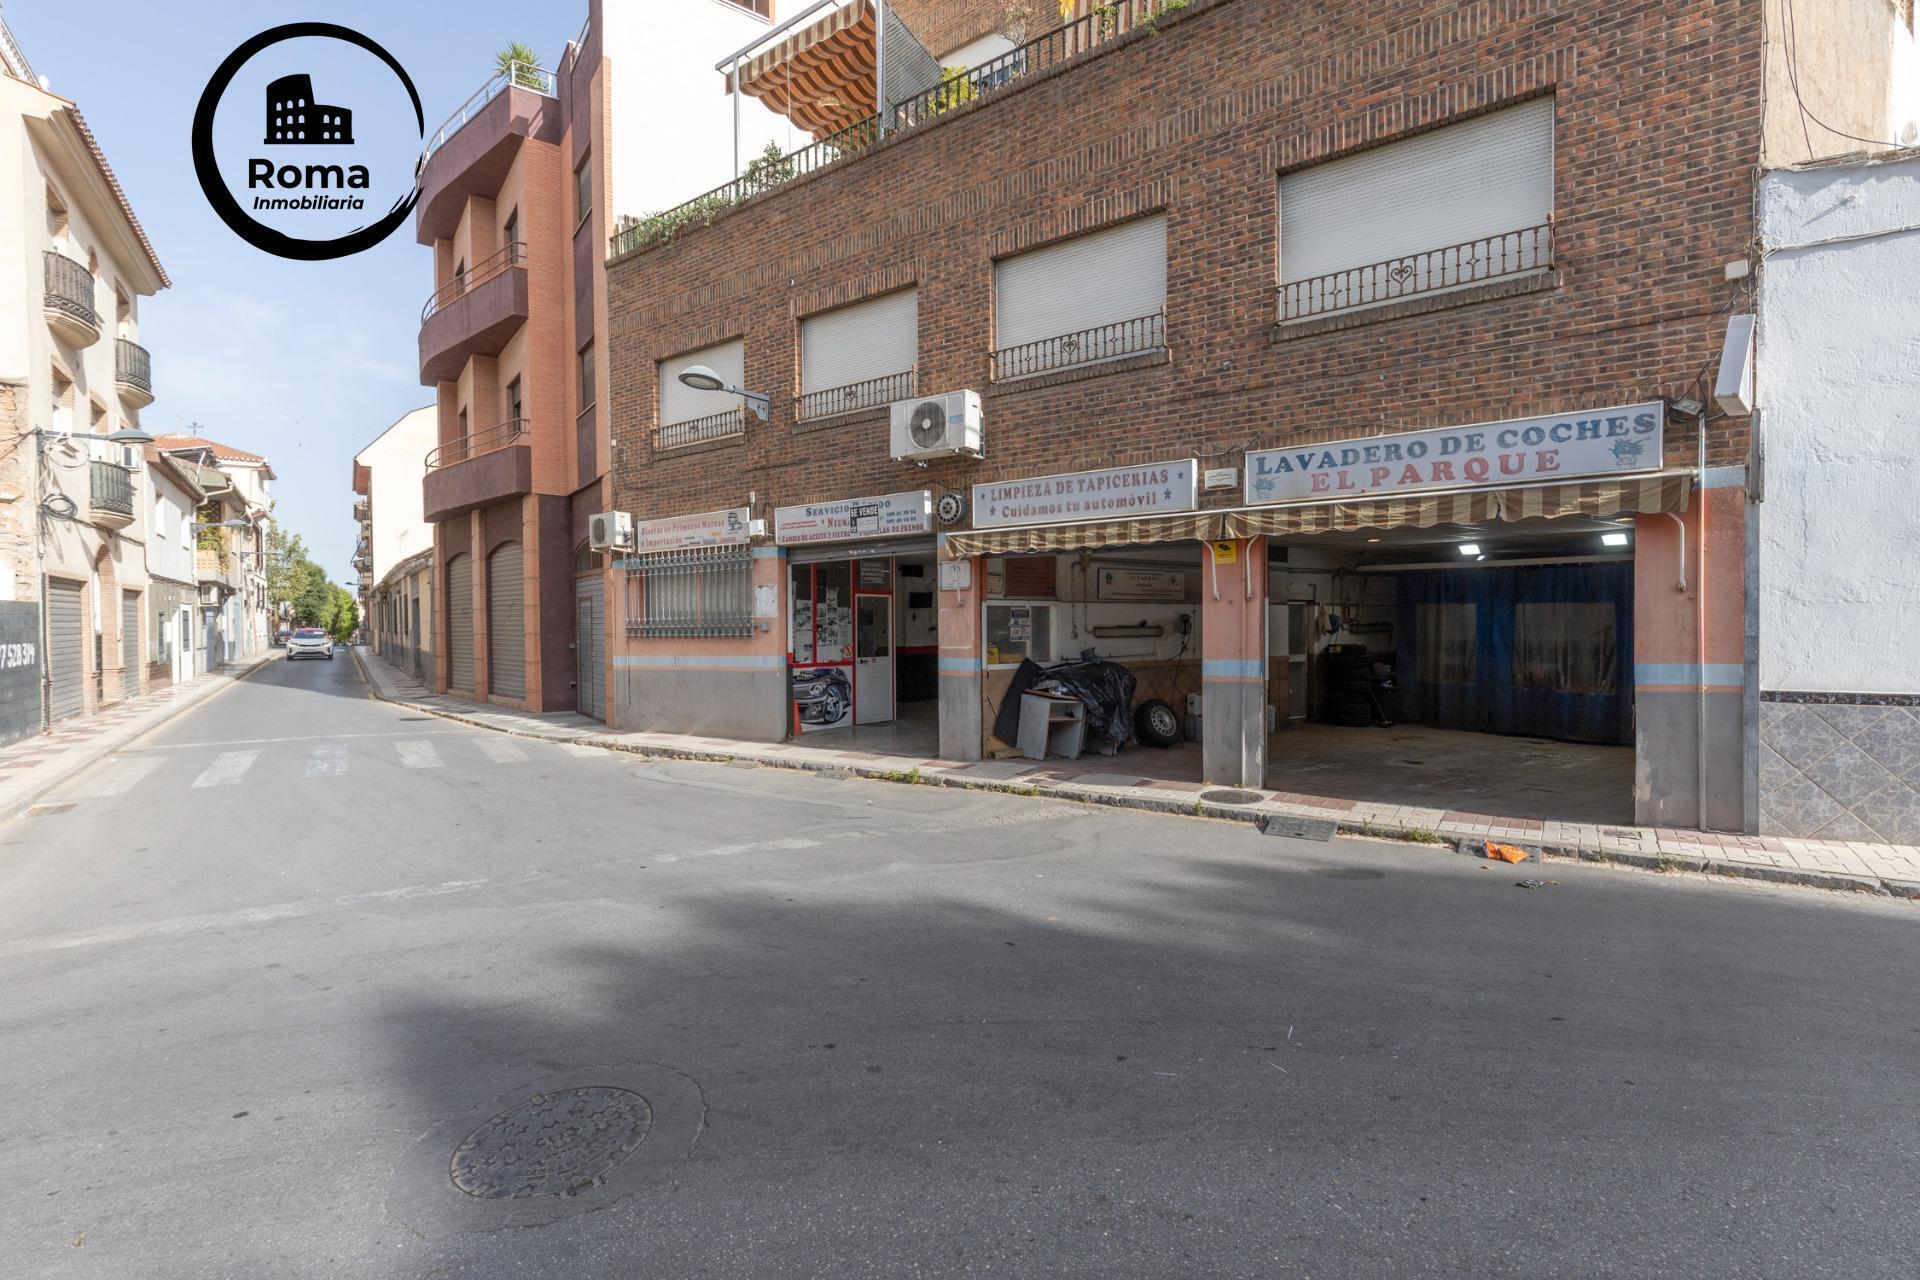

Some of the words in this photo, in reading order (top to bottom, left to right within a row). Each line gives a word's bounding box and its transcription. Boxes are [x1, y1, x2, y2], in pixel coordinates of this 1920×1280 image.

[1256, 440, 1429, 475] LAVADERO
[1439, 432, 1486, 456] DE
[1496, 412, 1657, 449] COCHES
[1310, 469, 1356, 493] EL
[1370, 449, 1562, 487] PARQUE
[990, 480, 1052, 502] LIMPIEZA
[1055, 481, 1074, 495] DE
[1077, 469, 1169, 492] TAPICERIAS
[805, 505, 850, 517] SERVICIO
[850, 509, 858, 517] SE
[858, 505, 879, 516] VENDE
[1001, 502, 1062, 519] Cuidamos
[1066, 500, 1080, 513] tu
[1084, 492, 1157, 510] automóvil
[0, 644, 6, 669] 7
